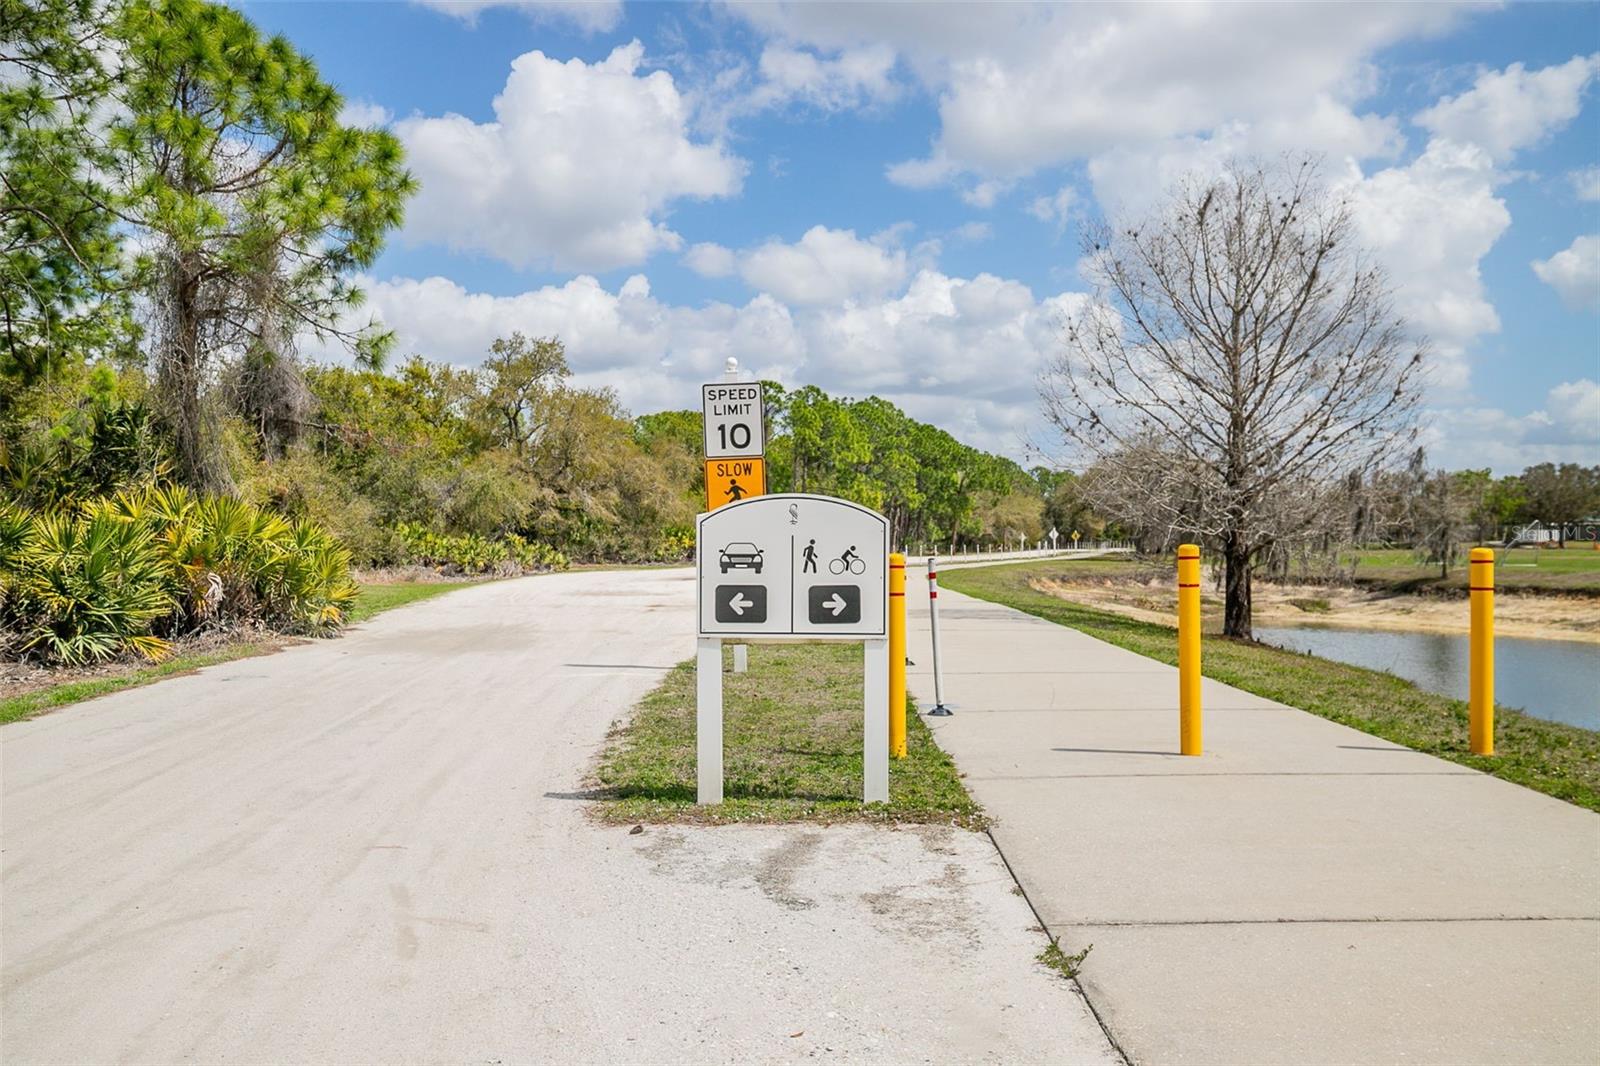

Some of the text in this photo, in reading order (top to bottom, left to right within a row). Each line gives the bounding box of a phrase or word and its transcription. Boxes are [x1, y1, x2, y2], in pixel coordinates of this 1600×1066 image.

[708, 389, 757, 401] SPEED
[714, 404, 751, 415] LIMIT
[717, 423, 751, 449] 10
[717, 463, 752, 477] SLOW
